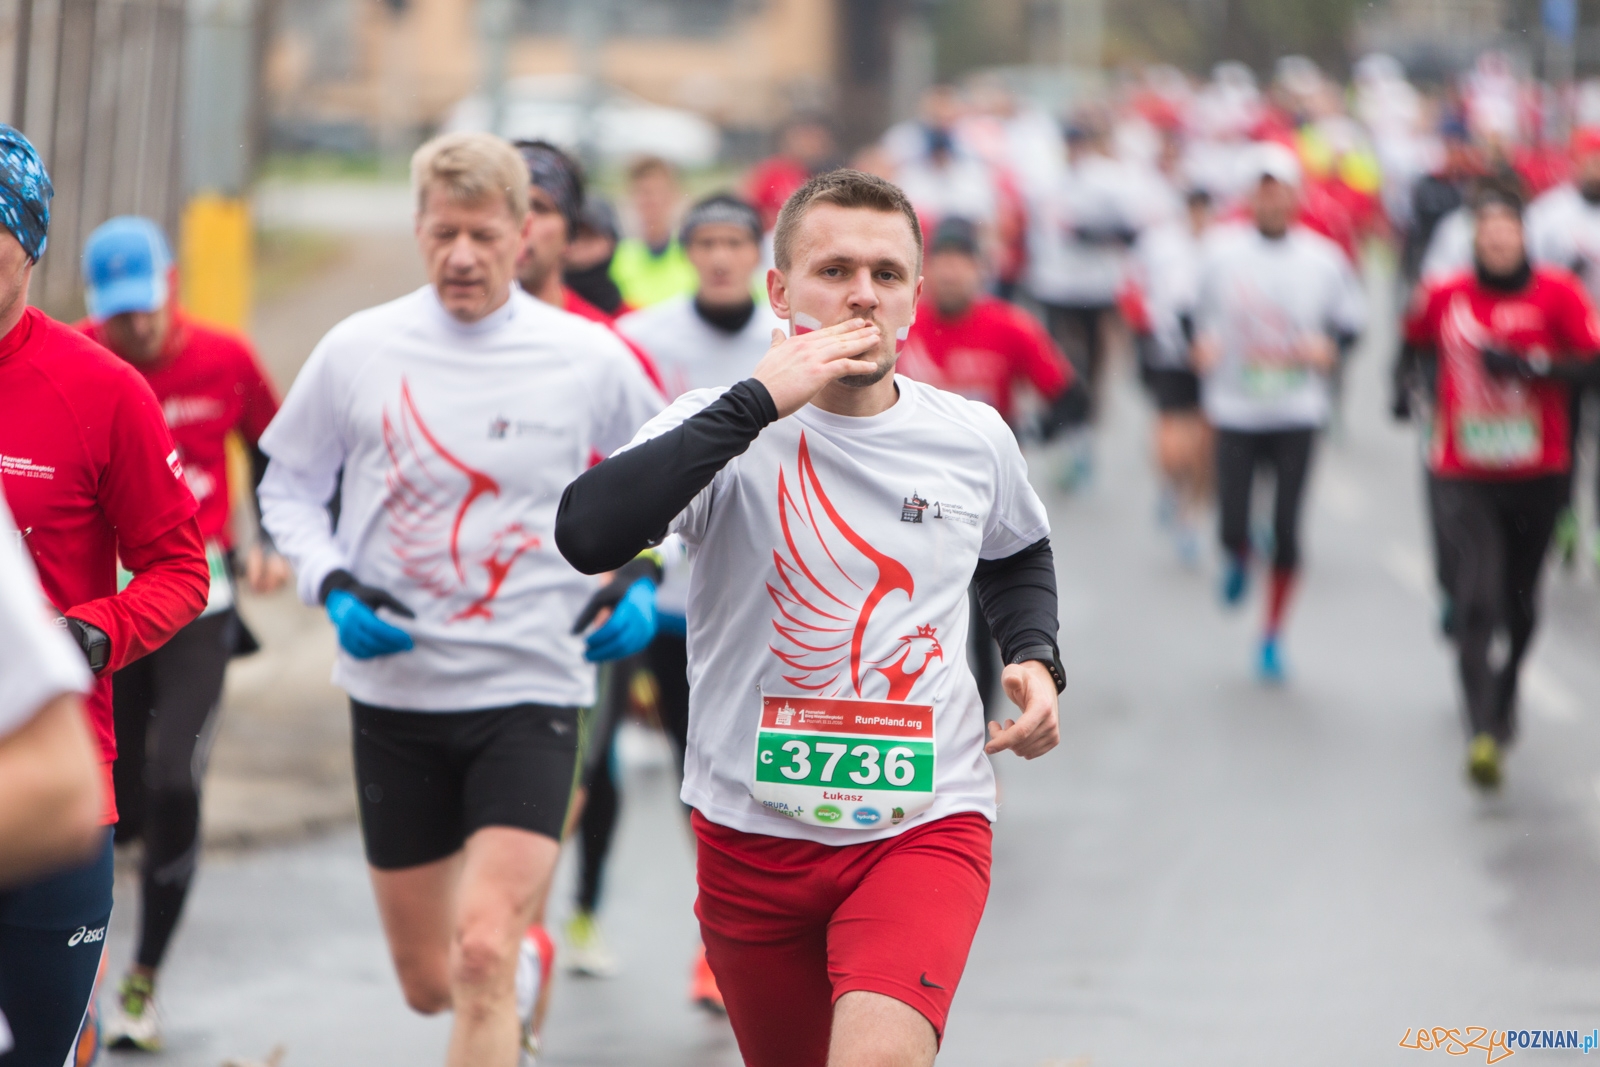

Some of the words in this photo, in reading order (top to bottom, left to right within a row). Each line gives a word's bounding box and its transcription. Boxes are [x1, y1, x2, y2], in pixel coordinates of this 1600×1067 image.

[934, 501, 942, 519] 1
[798, 709, 806, 722] 1
[855, 715, 922, 730] RunPoland.org
[779, 740, 916, 787] 3736
[823, 791, 863, 802] Łukasz
